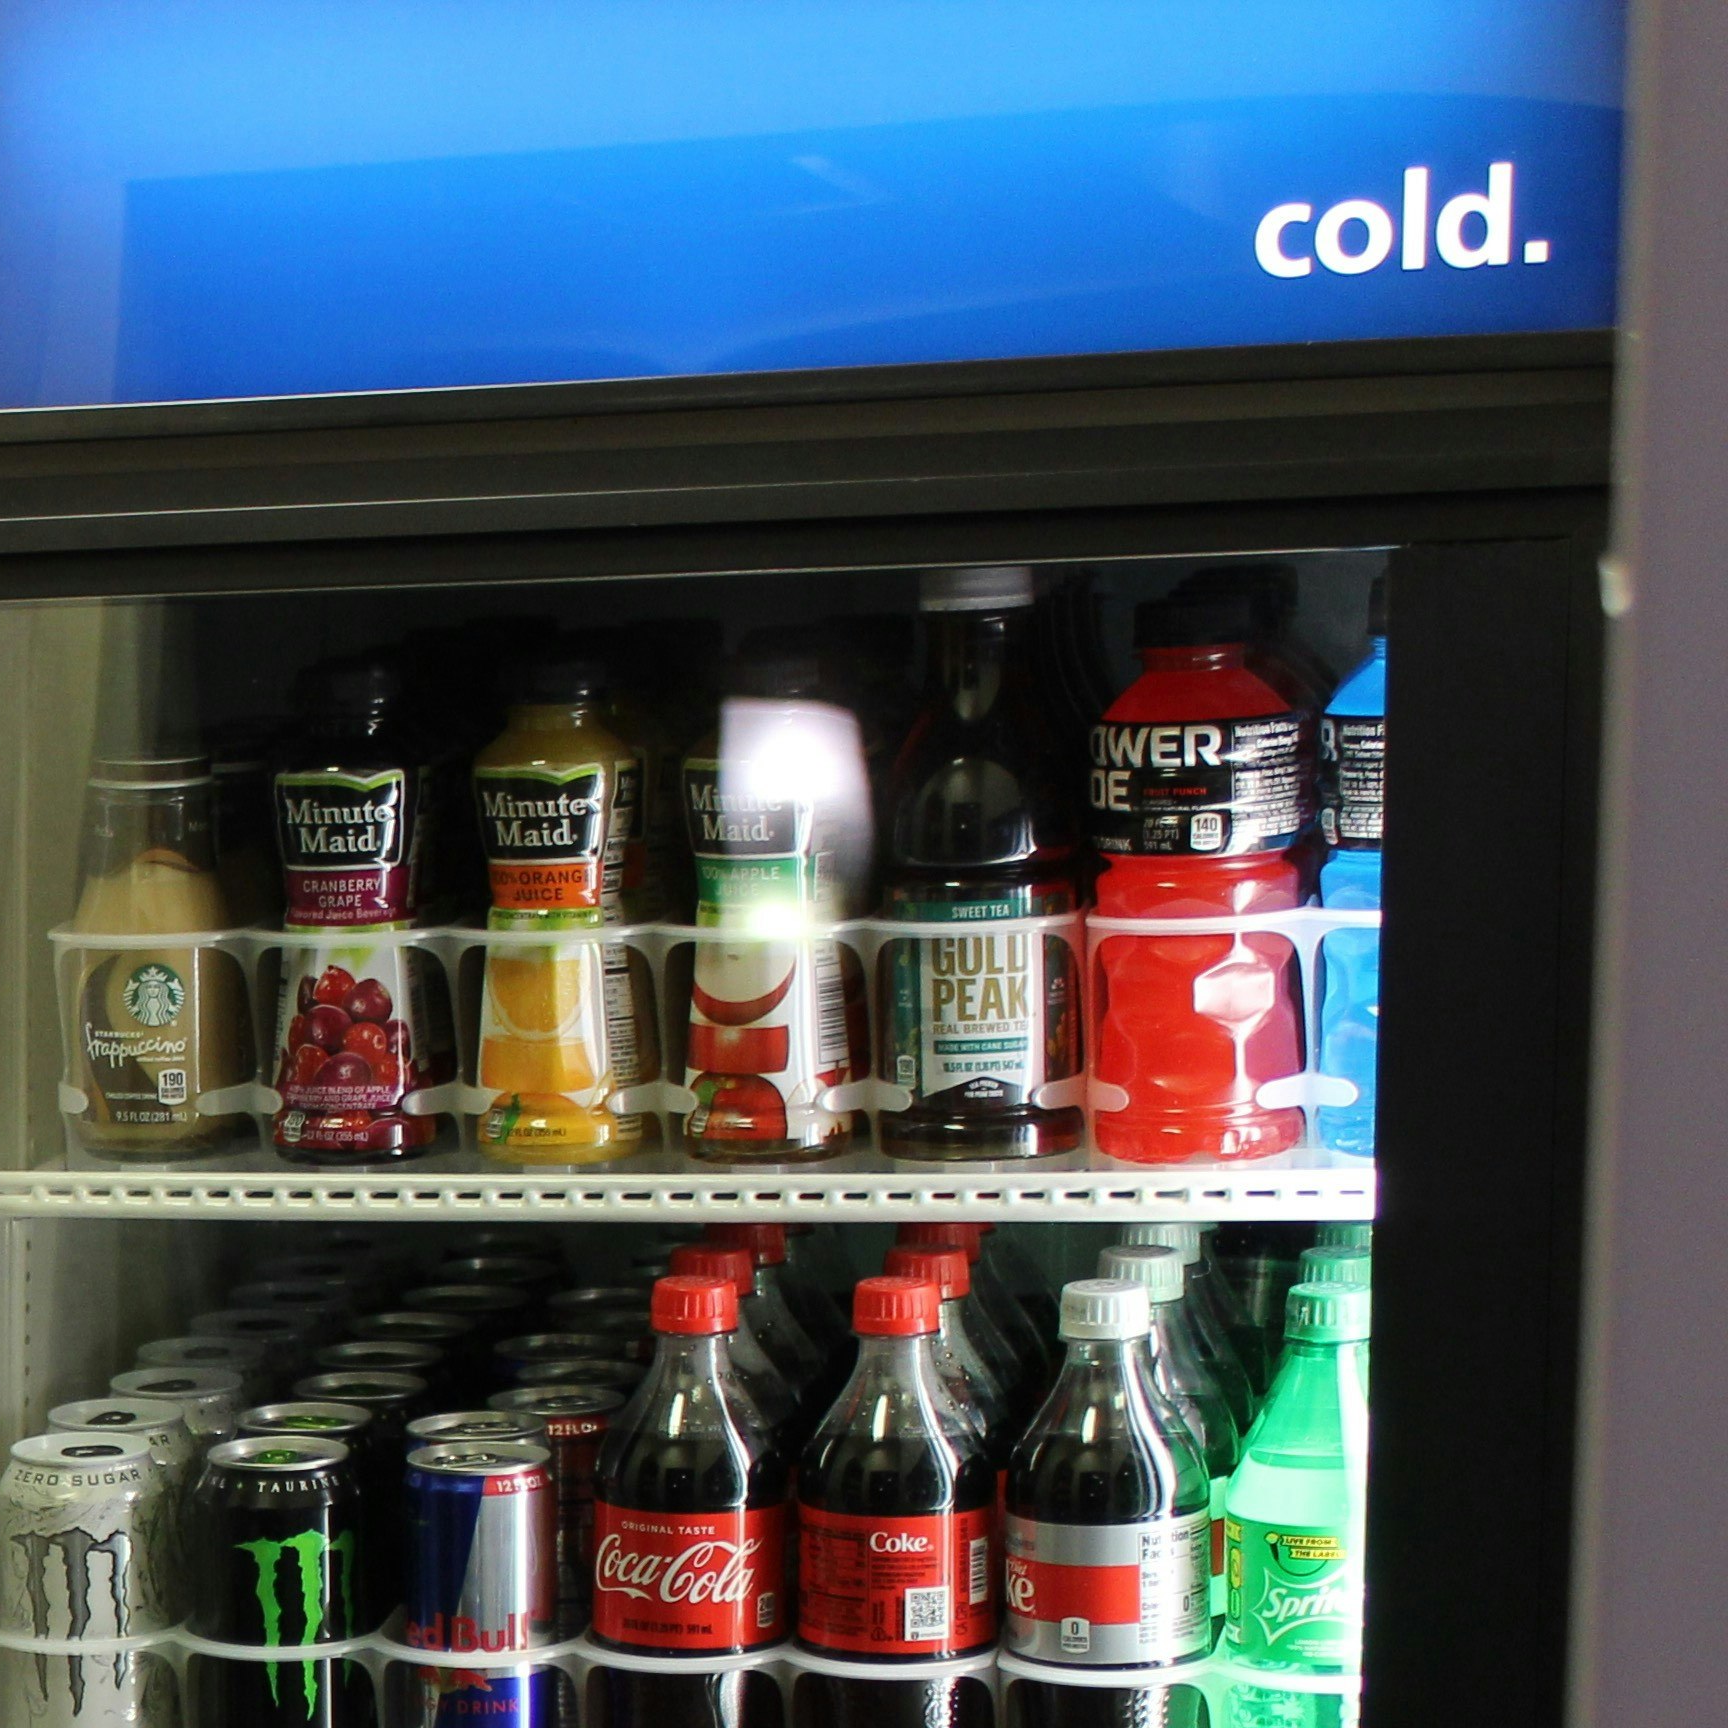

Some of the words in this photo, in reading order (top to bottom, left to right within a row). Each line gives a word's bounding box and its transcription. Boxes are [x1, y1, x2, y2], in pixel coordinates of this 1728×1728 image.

[1254, 162, 1548, 278] cold.
[1173, 786, 1208, 796] PUNCH
[285, 799, 389, 825] Minute
[482, 792, 588, 819] Minute
[703, 815, 773, 842] Maid
[1194, 816, 1219, 832] 140
[300, 826, 381, 853] Maid
[495, 820, 578, 847] Maid
[731, 866, 781, 881] APPLE
[302, 877, 382, 893] CRANBERRY
[319, 894, 362, 908] GRAPE
[513, 887, 564, 902] JUICE
[325, 908, 354, 918] Juice
[951, 905, 986, 919] SWEET
[989, 904, 1010, 917] TEA
[933, 975, 1029, 1023] PEAK
[933, 1022, 960, 1036] REAL
[963, 1020, 1010, 1035] BREWED
[162, 1072, 184, 1086] 190
[14, 1470, 61, 1488] ZERO
[69, 1467, 142, 1487] SUGAR
[621, 1521, 674, 1536] ORIGINAL
[677, 1524, 716, 1536] TASTE
[869, 1531, 927, 1553] Coke
[1285, 1537, 1304, 1546] LIVE
[1306, 1537, 1333, 1546] FROM
[595, 1532, 762, 1606] Coca-Cola
[1261, 1587, 1347, 1619] Spri
[450, 1611, 530, 1655] Bull
[1070, 1619, 1080, 1635] 0
[456, 1697, 520, 1717] DRINK
